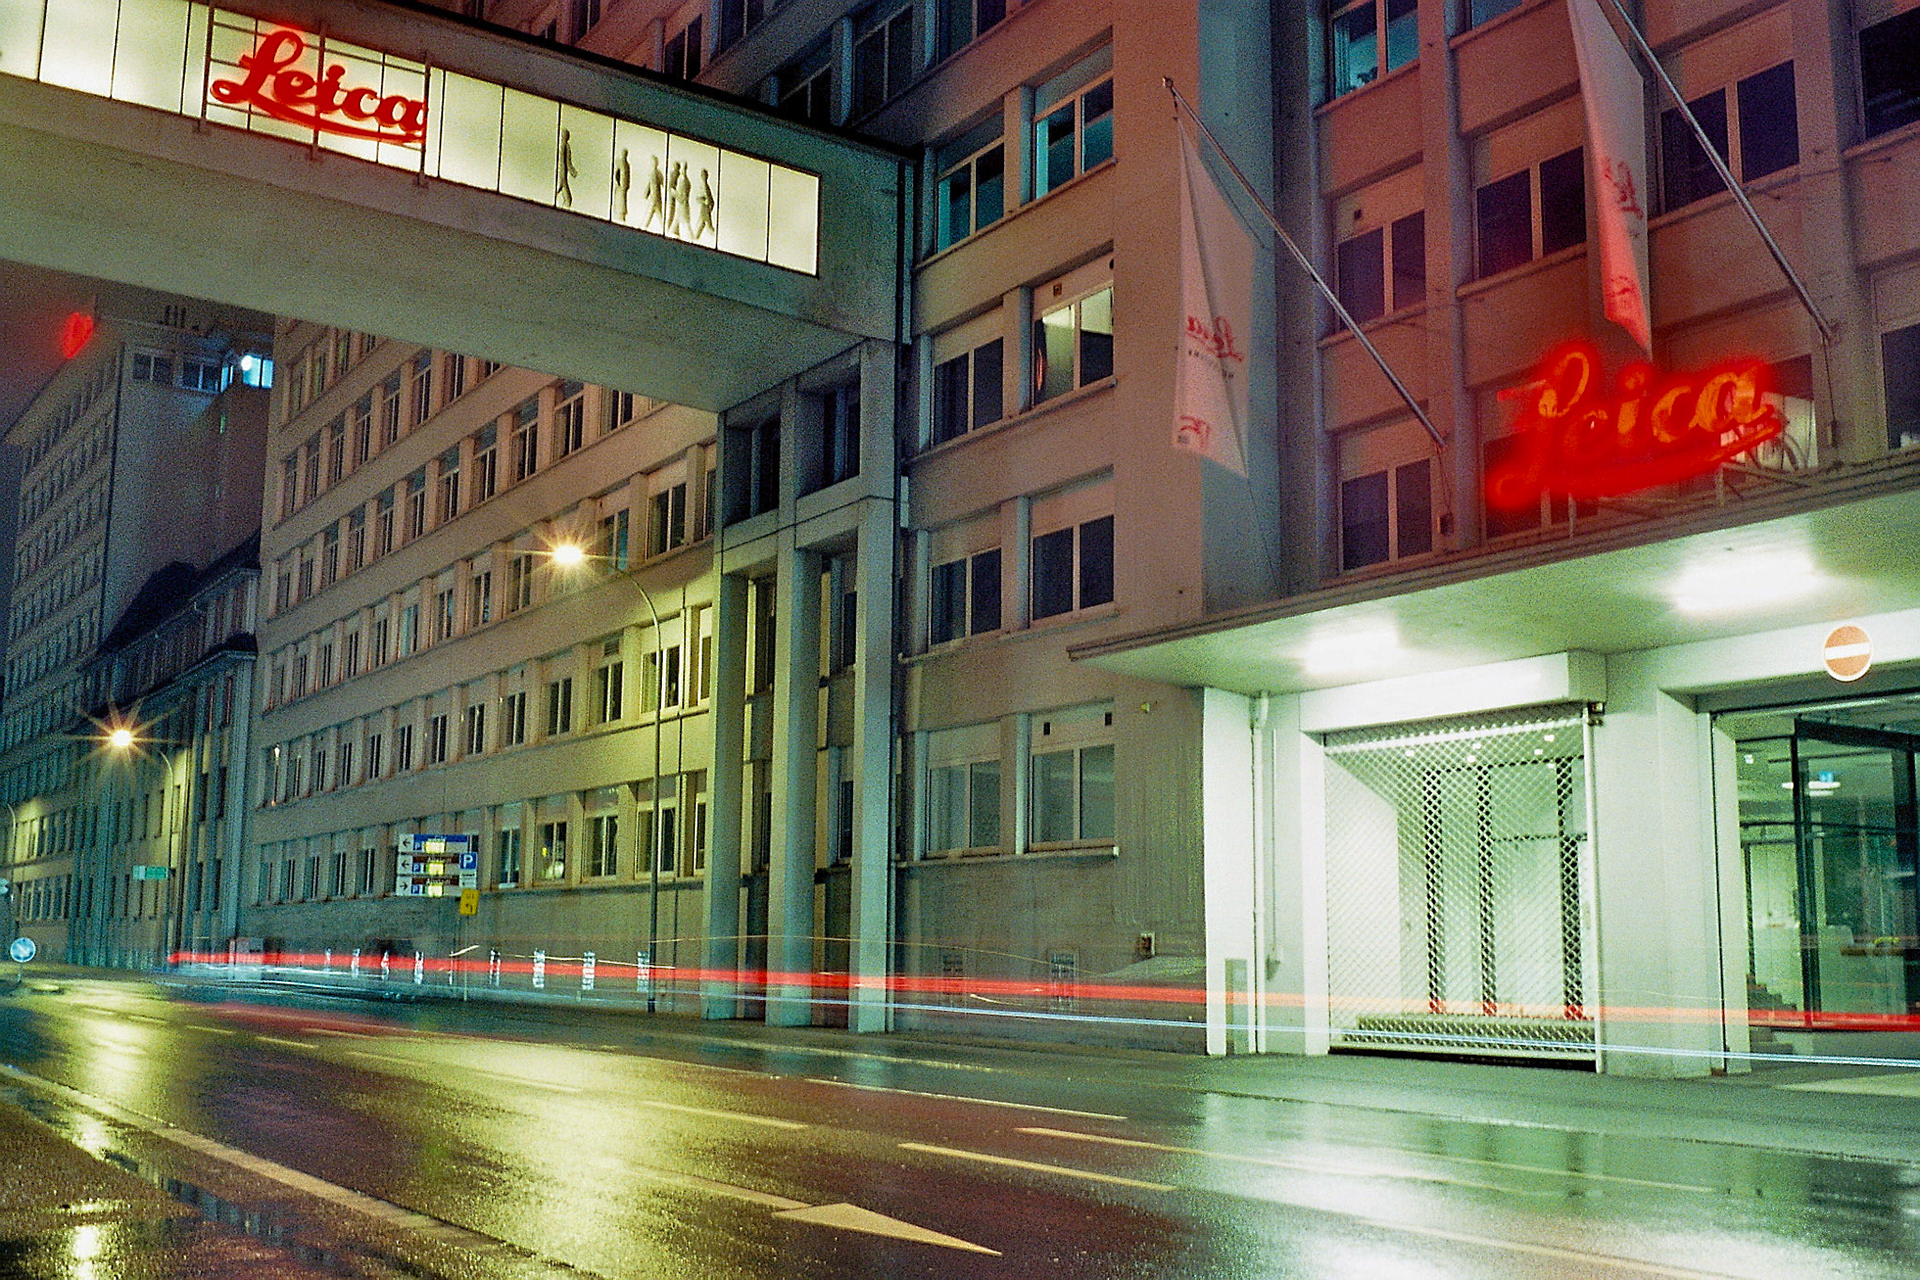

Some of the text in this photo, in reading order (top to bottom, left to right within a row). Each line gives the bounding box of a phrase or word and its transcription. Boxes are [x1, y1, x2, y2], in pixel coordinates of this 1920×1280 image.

[210, 31, 426, 142] Leica
[1490, 344, 1782, 505] Leica
[463, 854, 473, 869] P
